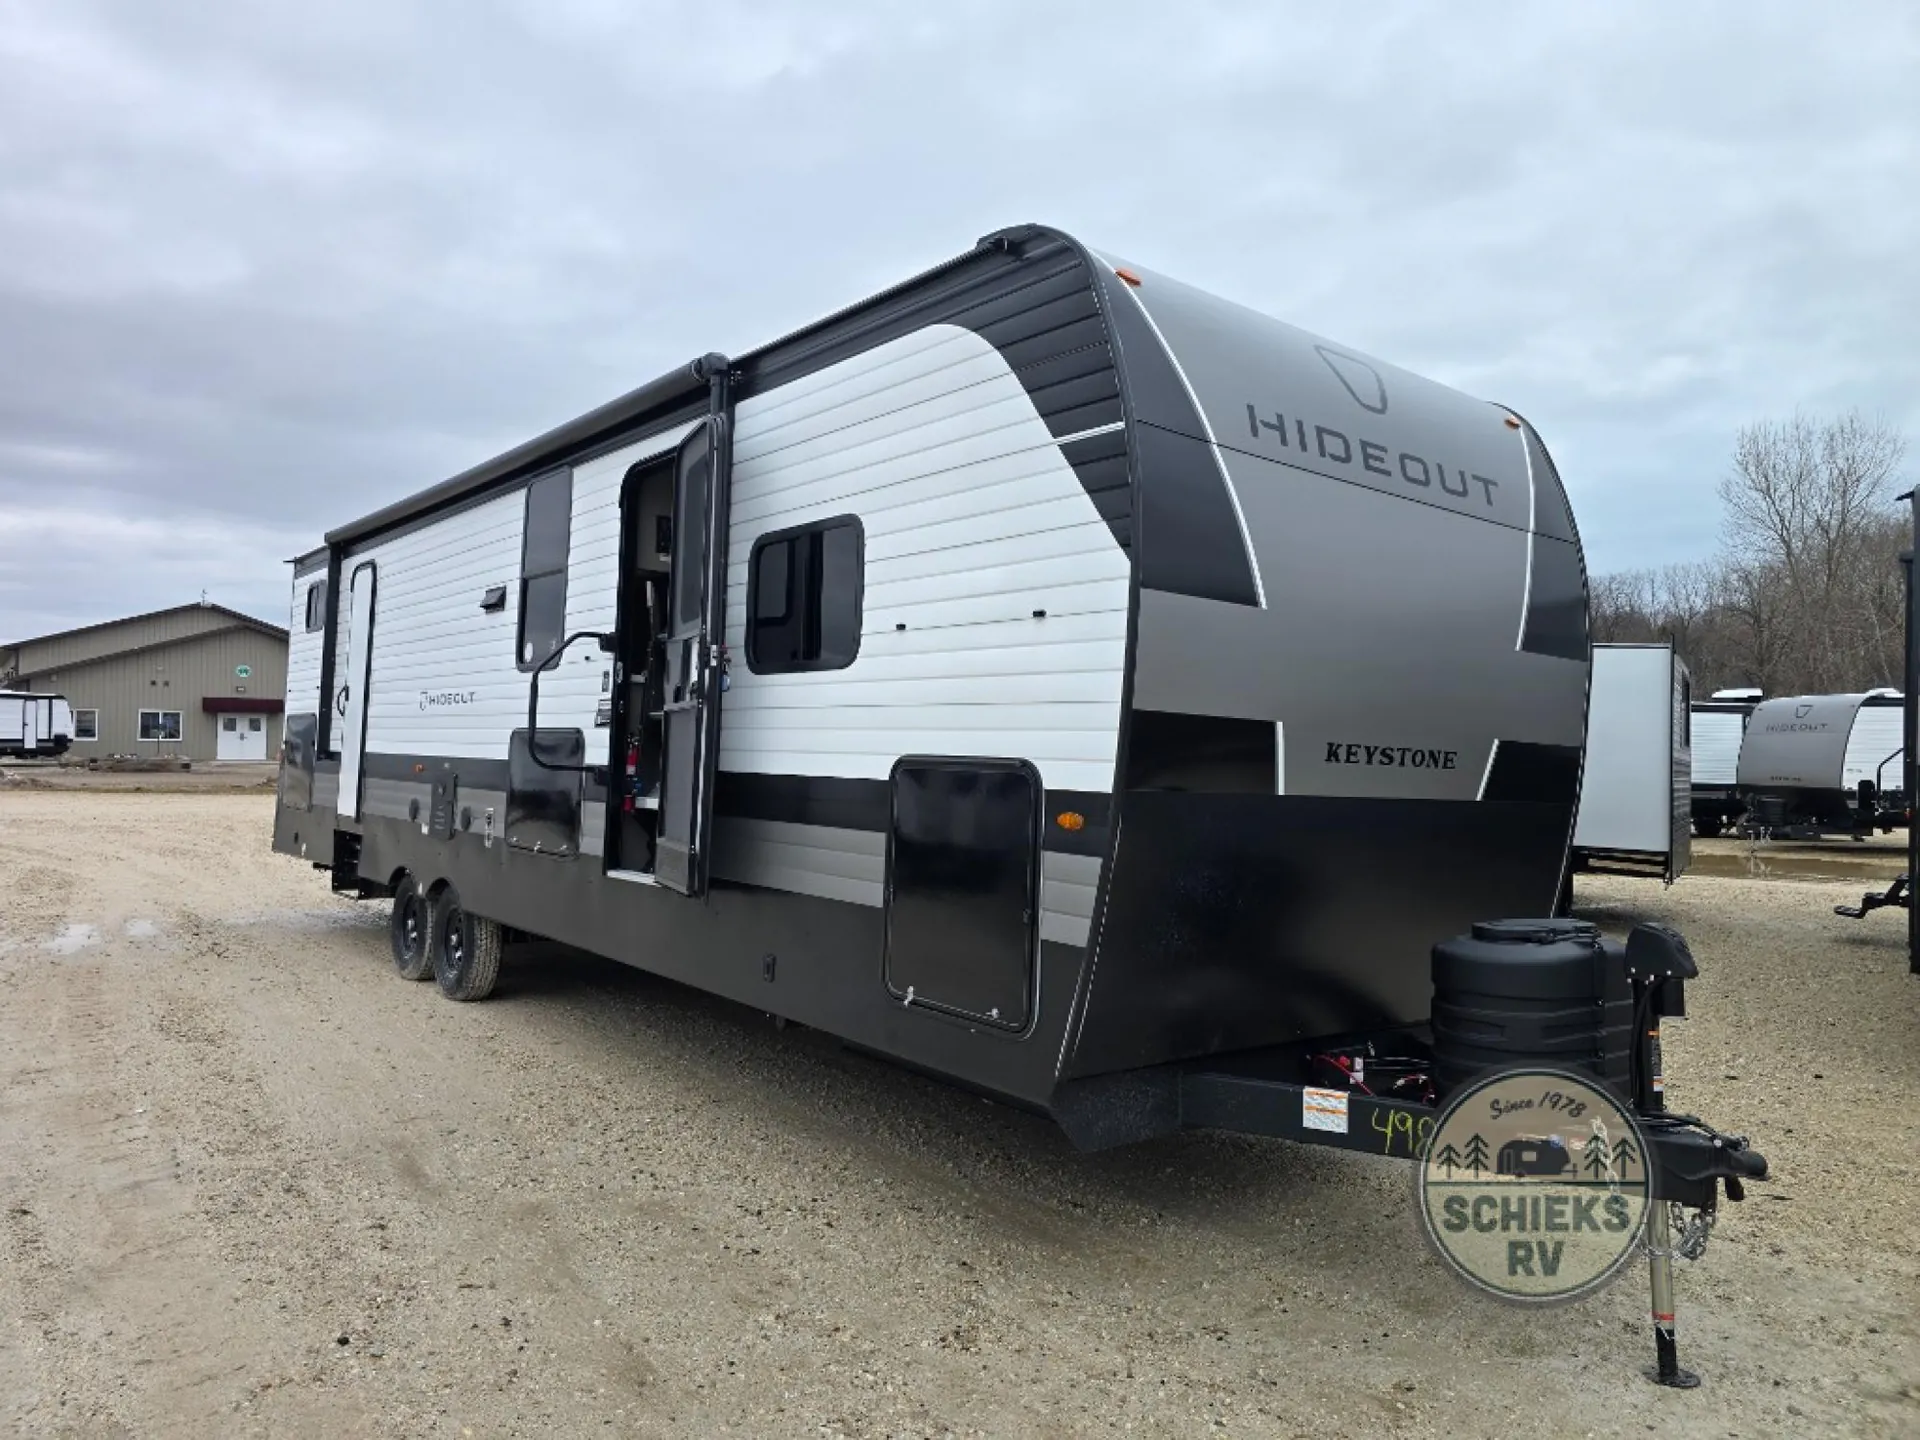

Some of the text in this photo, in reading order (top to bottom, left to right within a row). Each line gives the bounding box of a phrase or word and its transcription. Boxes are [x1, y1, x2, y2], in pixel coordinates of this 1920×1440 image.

[1246, 403, 1499, 507] HIDEOUT
[428, 691, 476, 706] HIDEOUT
[1324, 742, 1458, 770] KEYSTONE
